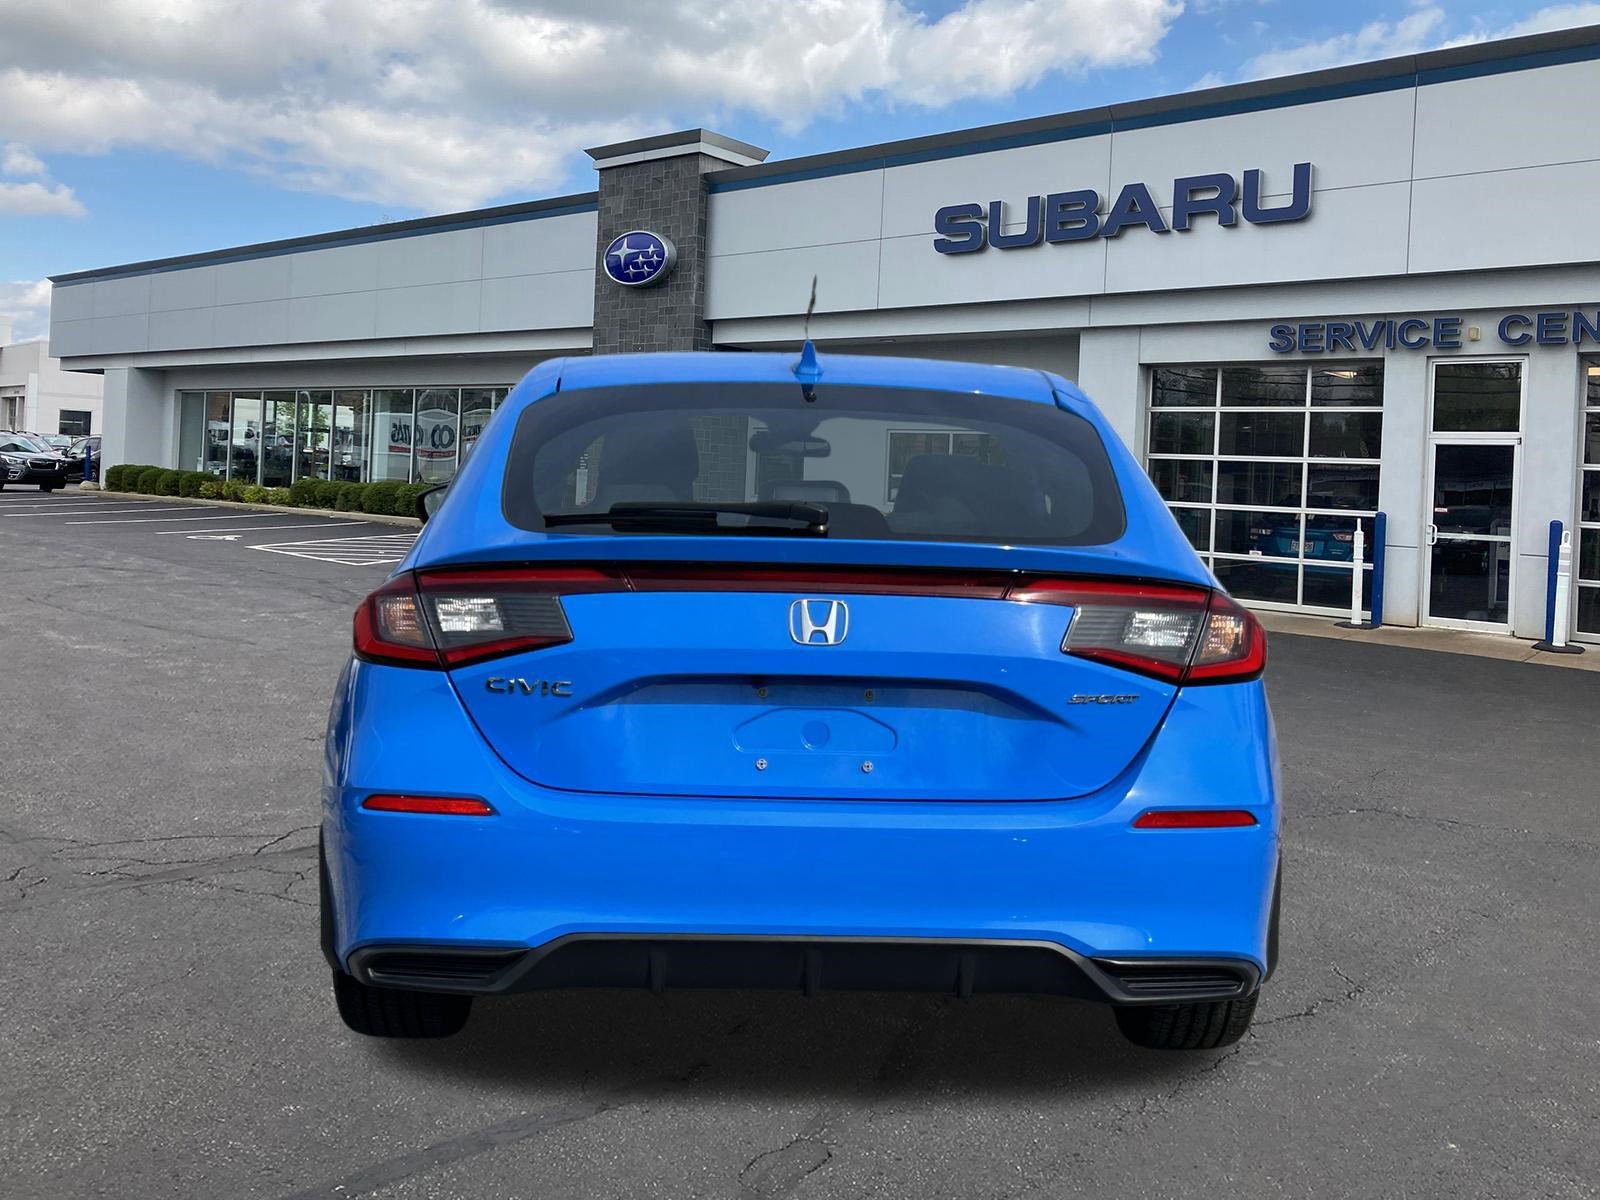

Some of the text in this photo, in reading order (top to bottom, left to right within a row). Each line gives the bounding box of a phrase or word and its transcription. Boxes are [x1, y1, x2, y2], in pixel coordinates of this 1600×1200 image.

[934, 162, 1313, 255] SUBARU
[1269, 311, 1600, 352] SERVICE CEN
[485, 676, 574, 698] CIVIC
[1066, 693, 1140, 705] SPORT
